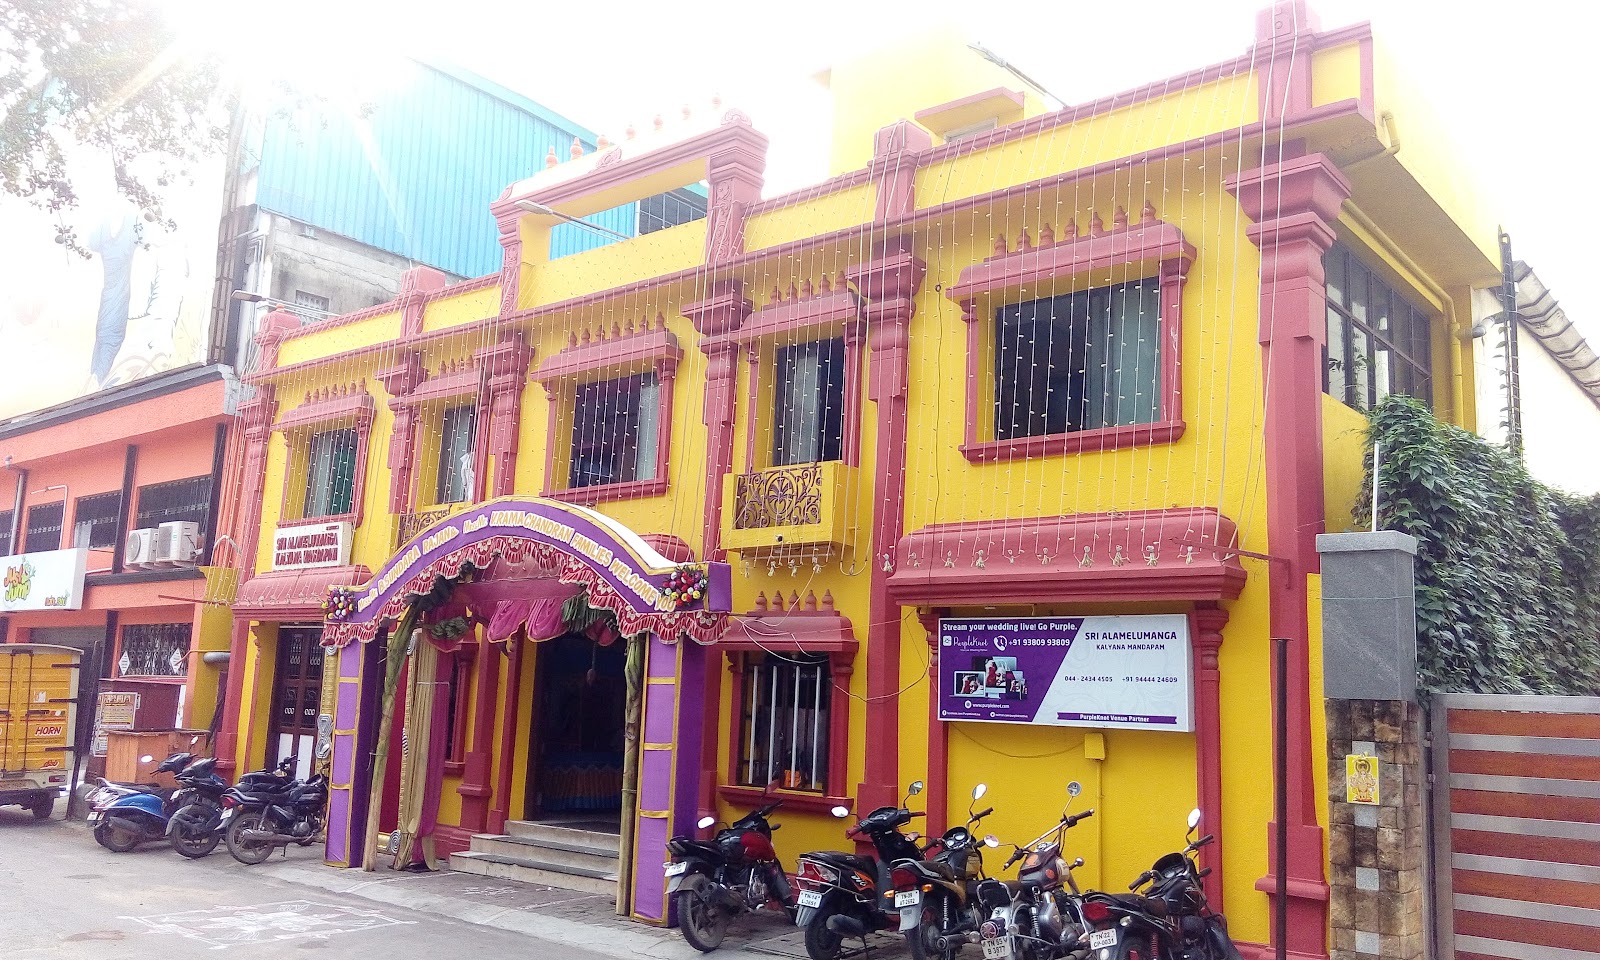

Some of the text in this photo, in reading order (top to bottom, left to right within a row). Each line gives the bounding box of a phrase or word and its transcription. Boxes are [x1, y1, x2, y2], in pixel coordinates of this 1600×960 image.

[570, 532, 613, 567] FAMILIES
[608, 558, 659, 606] WELCOME
[942, 623, 967, 631] Stream
[969, 624, 985, 632] your
[987, 623, 1019, 632] wedding
[1038, 622, 1048, 631] Go
[1049, 622, 1077, 632] Purple.
[1085, 631, 1177, 641] SRI ALAMELUMANGA
[1022, 638, 1046, 647] 93809
[1047, 638, 1071, 647] 93809
[1096, 643, 1165, 651] KALYANA MANDAPAM
[1064, 675, 1076, 683] 044
[1110, 714, 1128, 722] Venue
[1128, 715, 1150, 723] Partner
[34, 726, 63, 736] HORN
